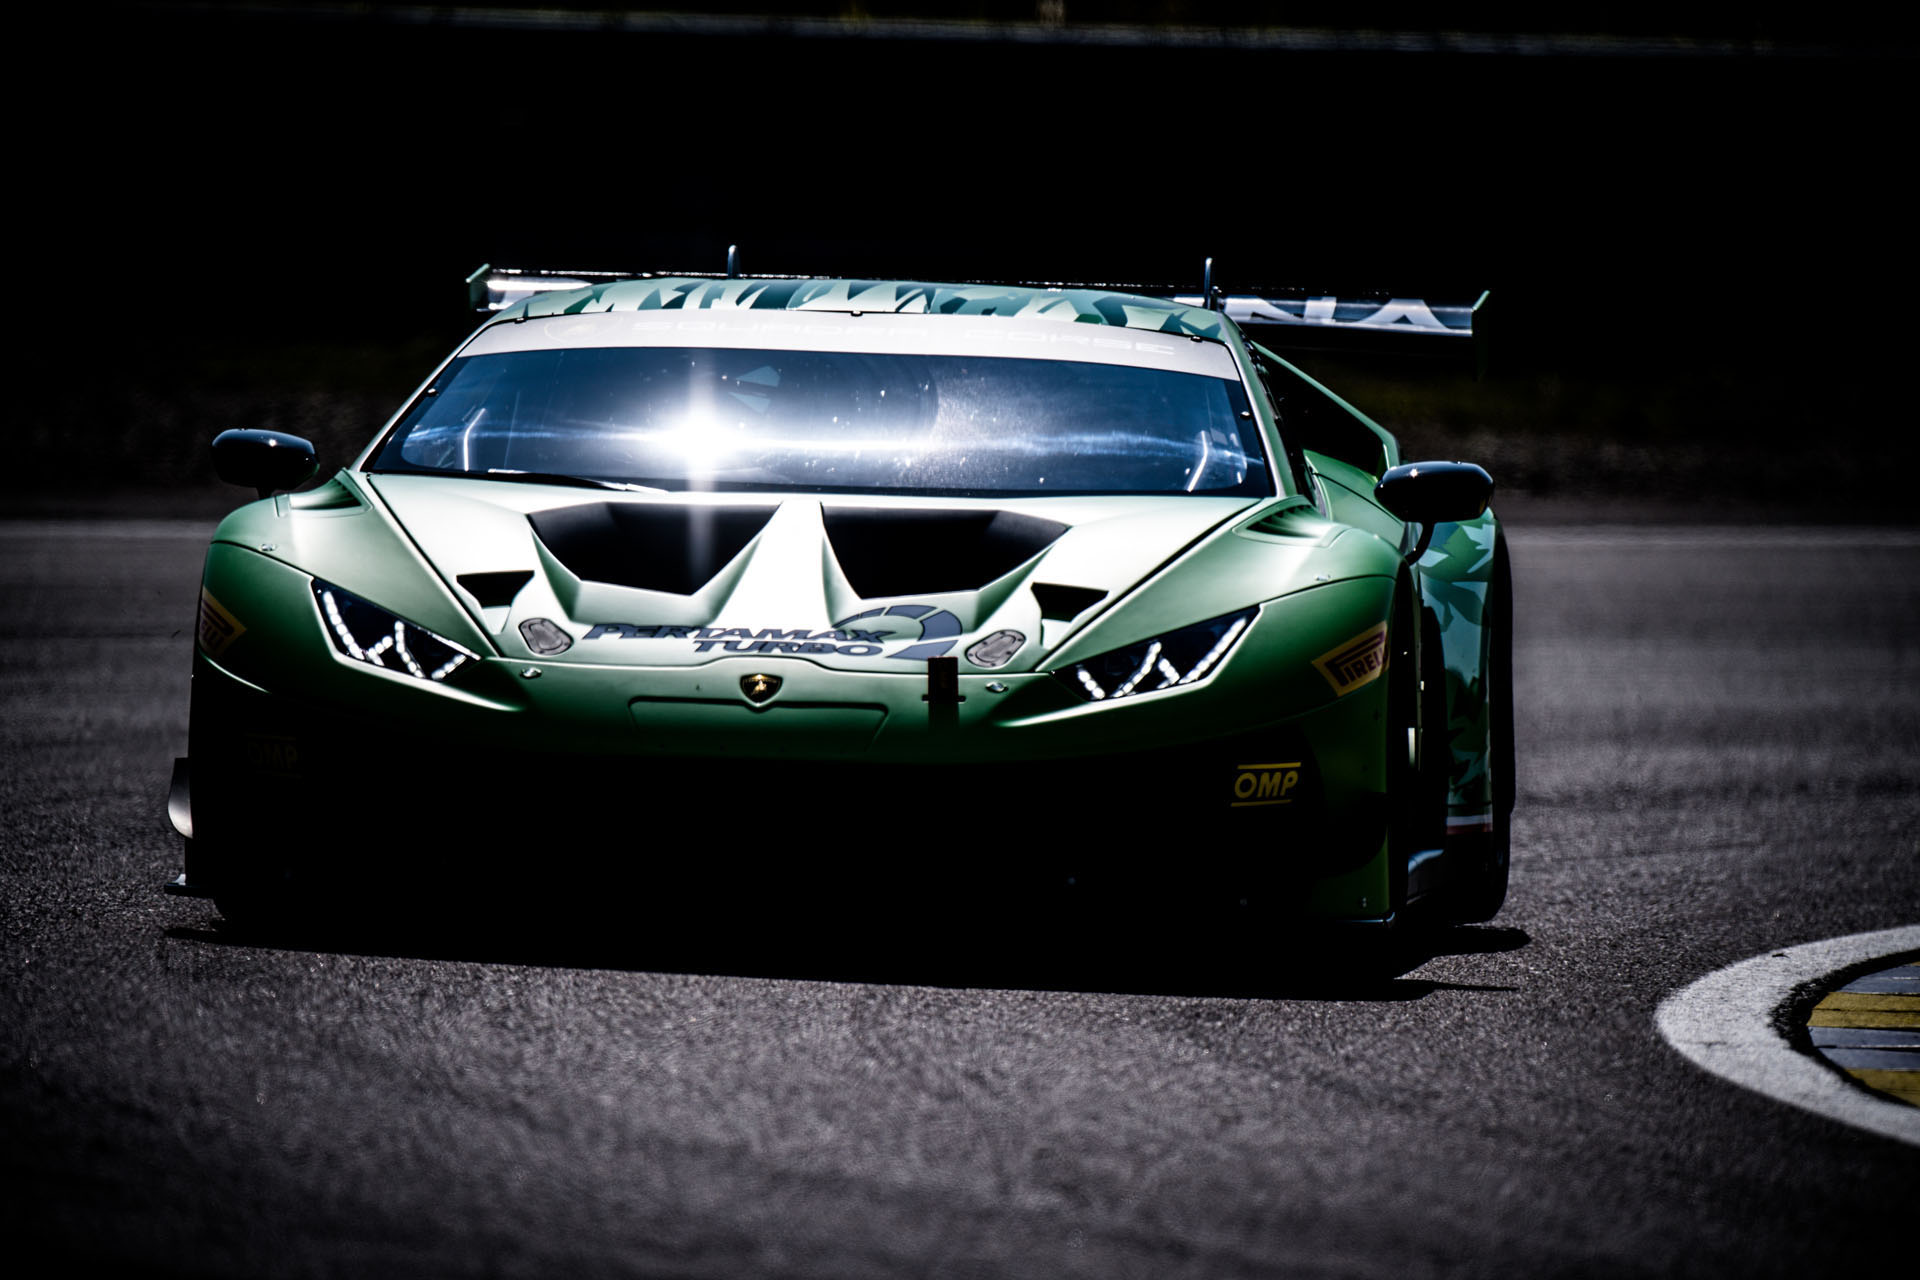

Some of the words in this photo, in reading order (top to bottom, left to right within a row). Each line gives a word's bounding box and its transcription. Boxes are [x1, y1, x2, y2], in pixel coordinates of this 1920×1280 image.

[582, 623, 897, 643] PERTAMAX
[693, 640, 884, 657] TURBO
[1234, 770, 1299, 799] OMP
